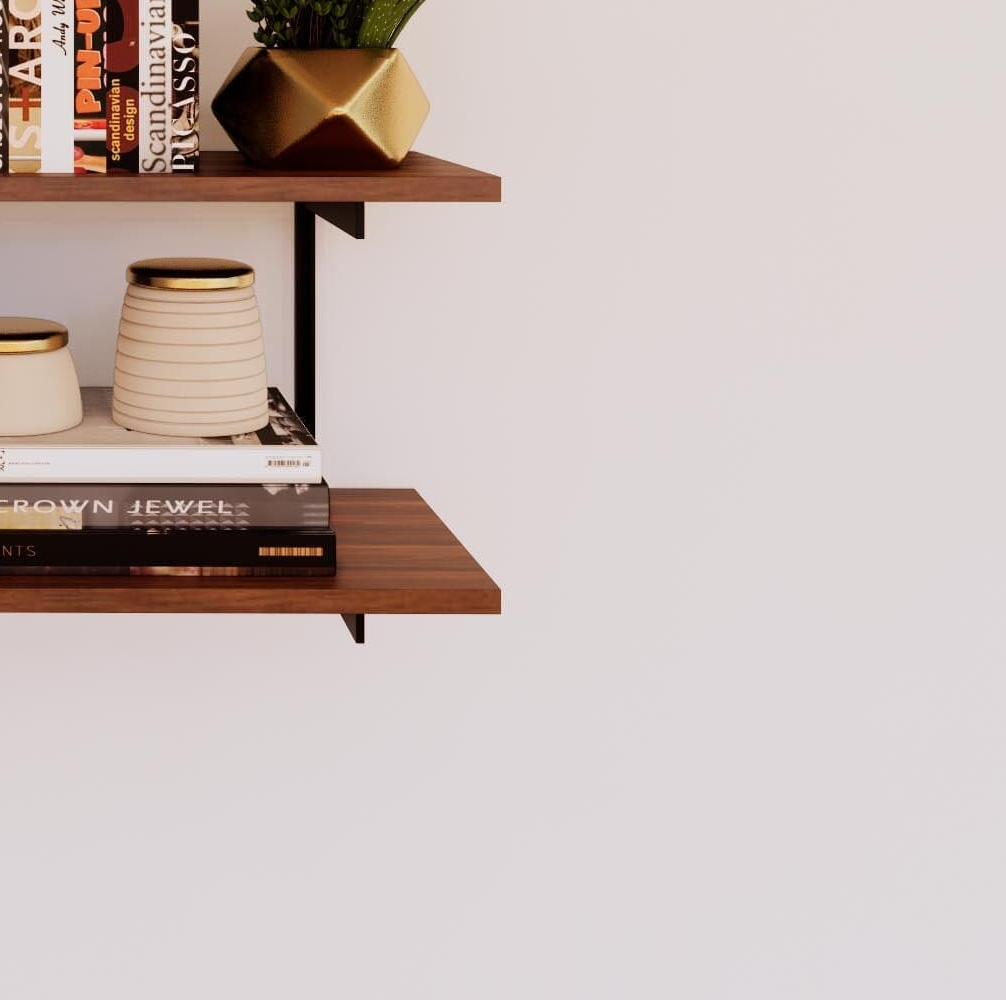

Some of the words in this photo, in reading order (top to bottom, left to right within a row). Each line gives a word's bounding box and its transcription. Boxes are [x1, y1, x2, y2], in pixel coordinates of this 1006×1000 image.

[51, 22, 69, 56] Andy
[109, 79, 120, 161] scandinavian
[124, 98, 137, 141] design
[172, 32, 195, 170] PICASSO
[127, 499, 233, 515] JEWEL
